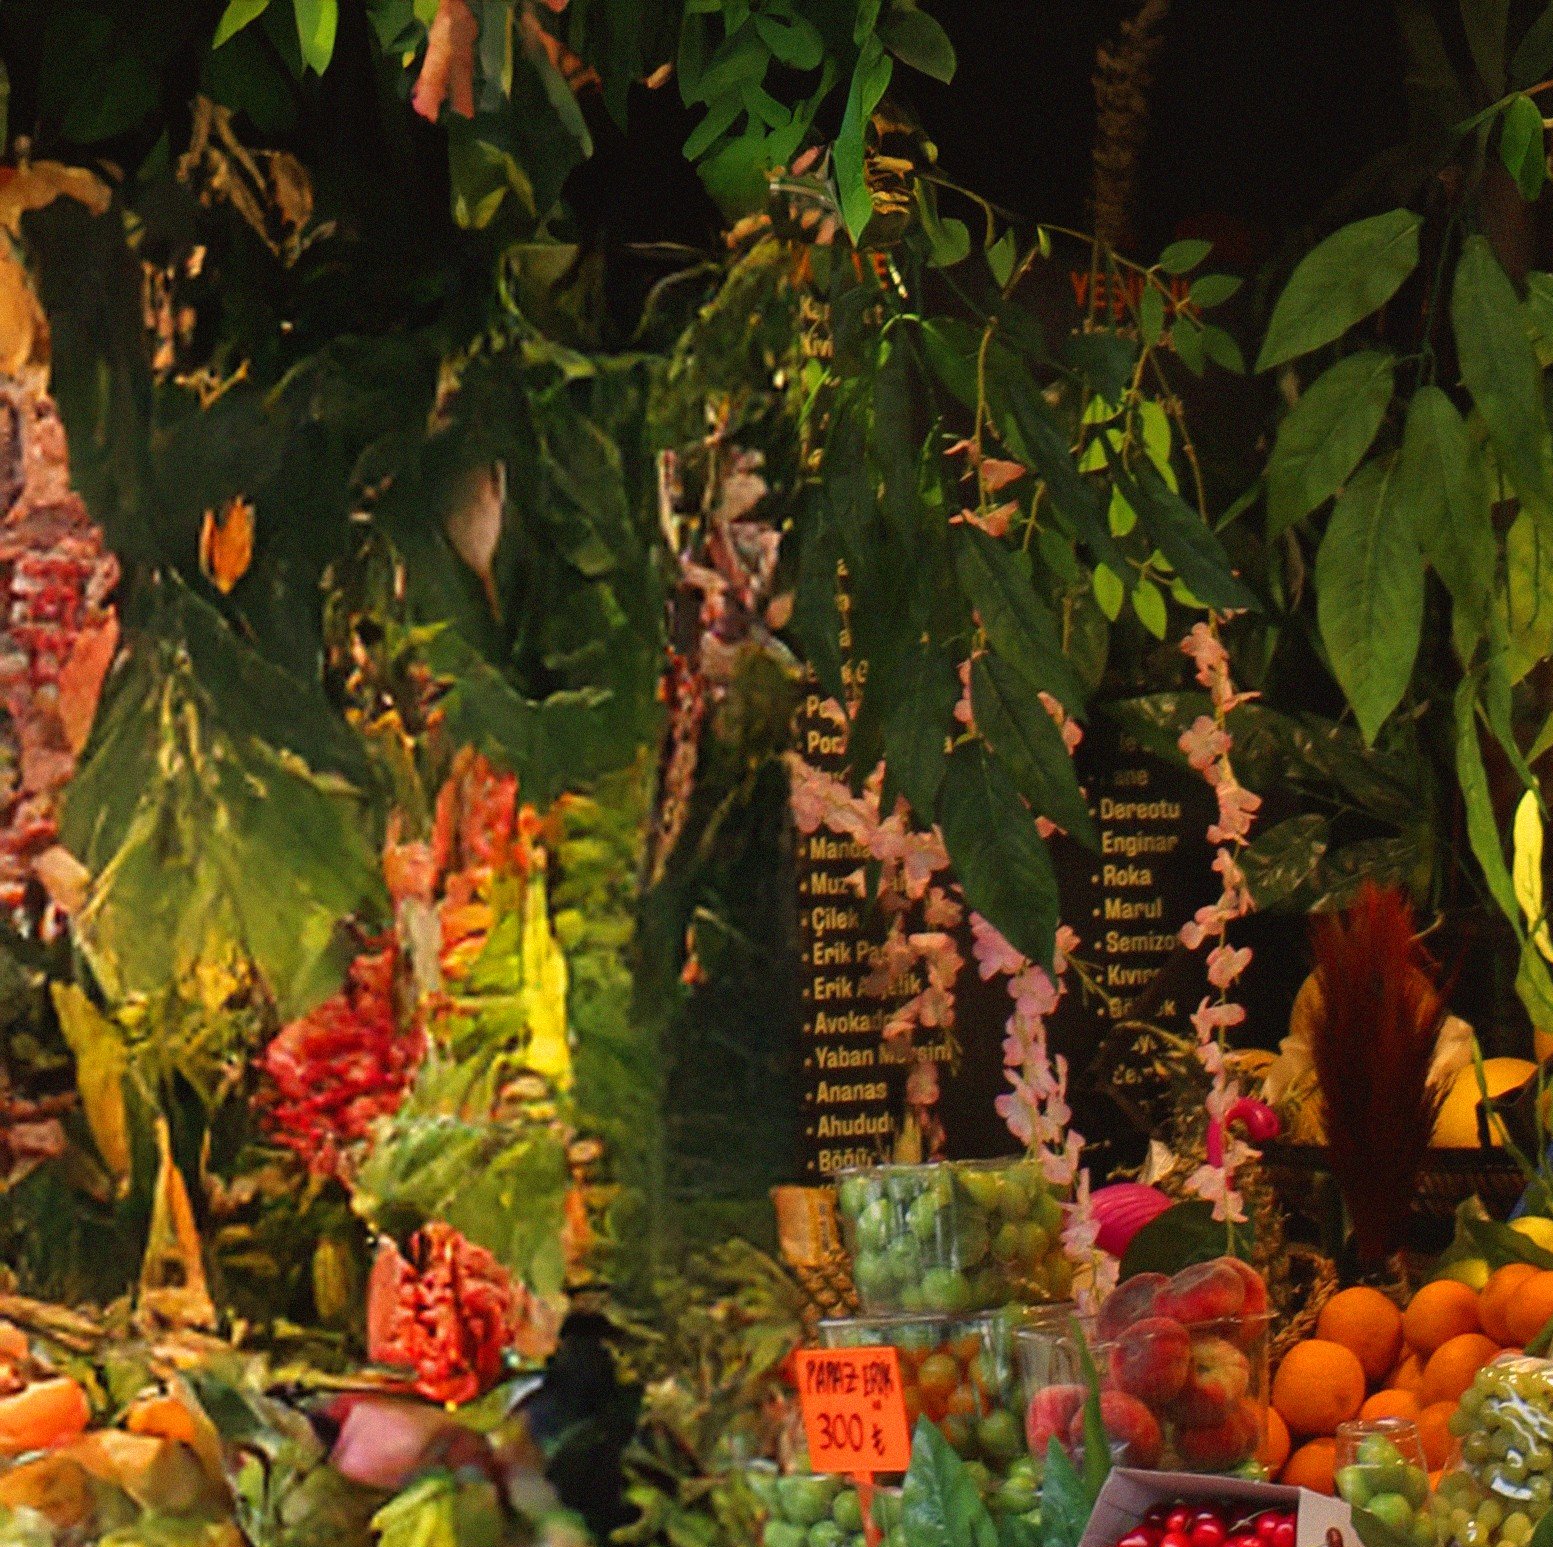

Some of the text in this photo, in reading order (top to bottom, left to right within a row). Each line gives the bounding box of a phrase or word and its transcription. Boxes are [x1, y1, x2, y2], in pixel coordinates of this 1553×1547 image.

[1100, 797, 1181, 820] Dereotu
[1102, 830, 1179, 857] Enginar
[811, 871, 850, 895] Muz
[1103, 864, 1153, 887] Roka
[1104, 897, 1163, 920] Marul
[811, 907, 859, 937] Çilek
[1106, 930, 1178, 953] Semizo
[813, 942, 852, 966] Erik
[814, 976, 853, 1001] Erik
[815, 1043, 874, 1068] Yaban
[816, 1080, 889, 1104] Ananas
[817, 1412, 863, 1452] 300
